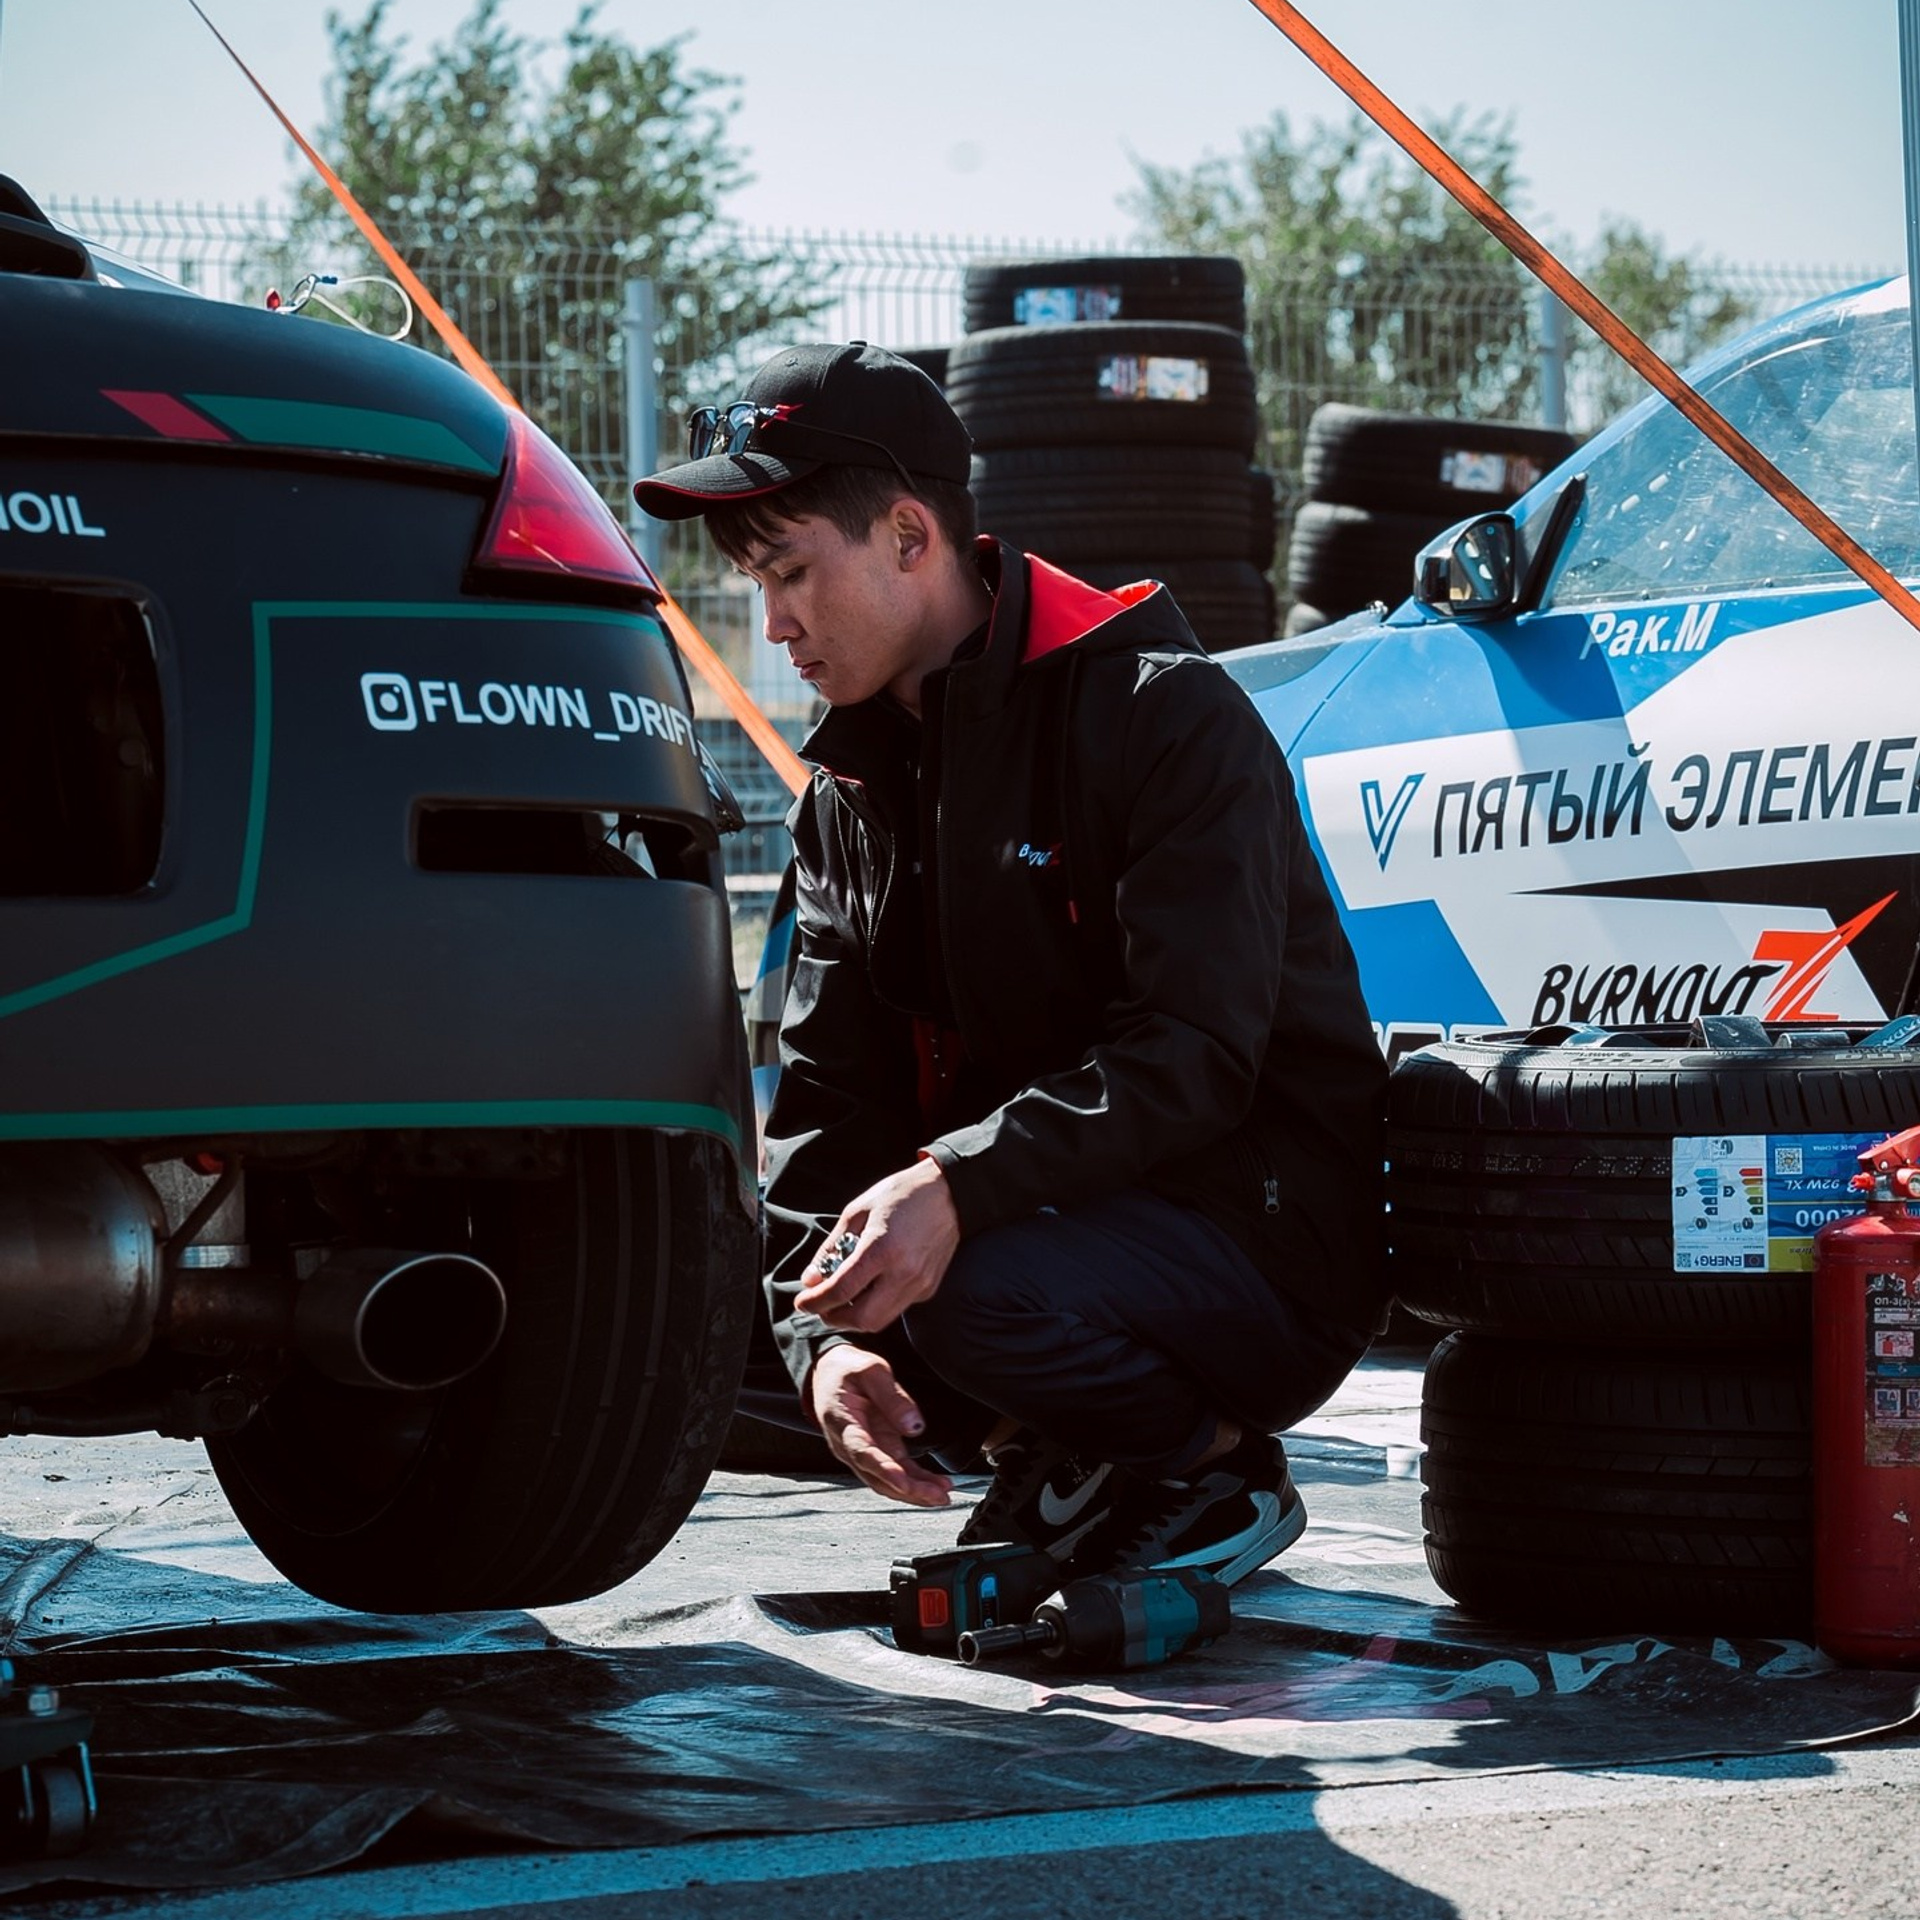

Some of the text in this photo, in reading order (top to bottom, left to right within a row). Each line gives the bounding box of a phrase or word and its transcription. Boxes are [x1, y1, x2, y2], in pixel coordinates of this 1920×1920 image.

[1433, 742, 1652, 858] ПЯТЫЙ
[1784, 1179, 1803, 1190] XL
[1806, 1178, 1840, 1189] 92W
[1700, 1255, 1742, 1267] ENERG
